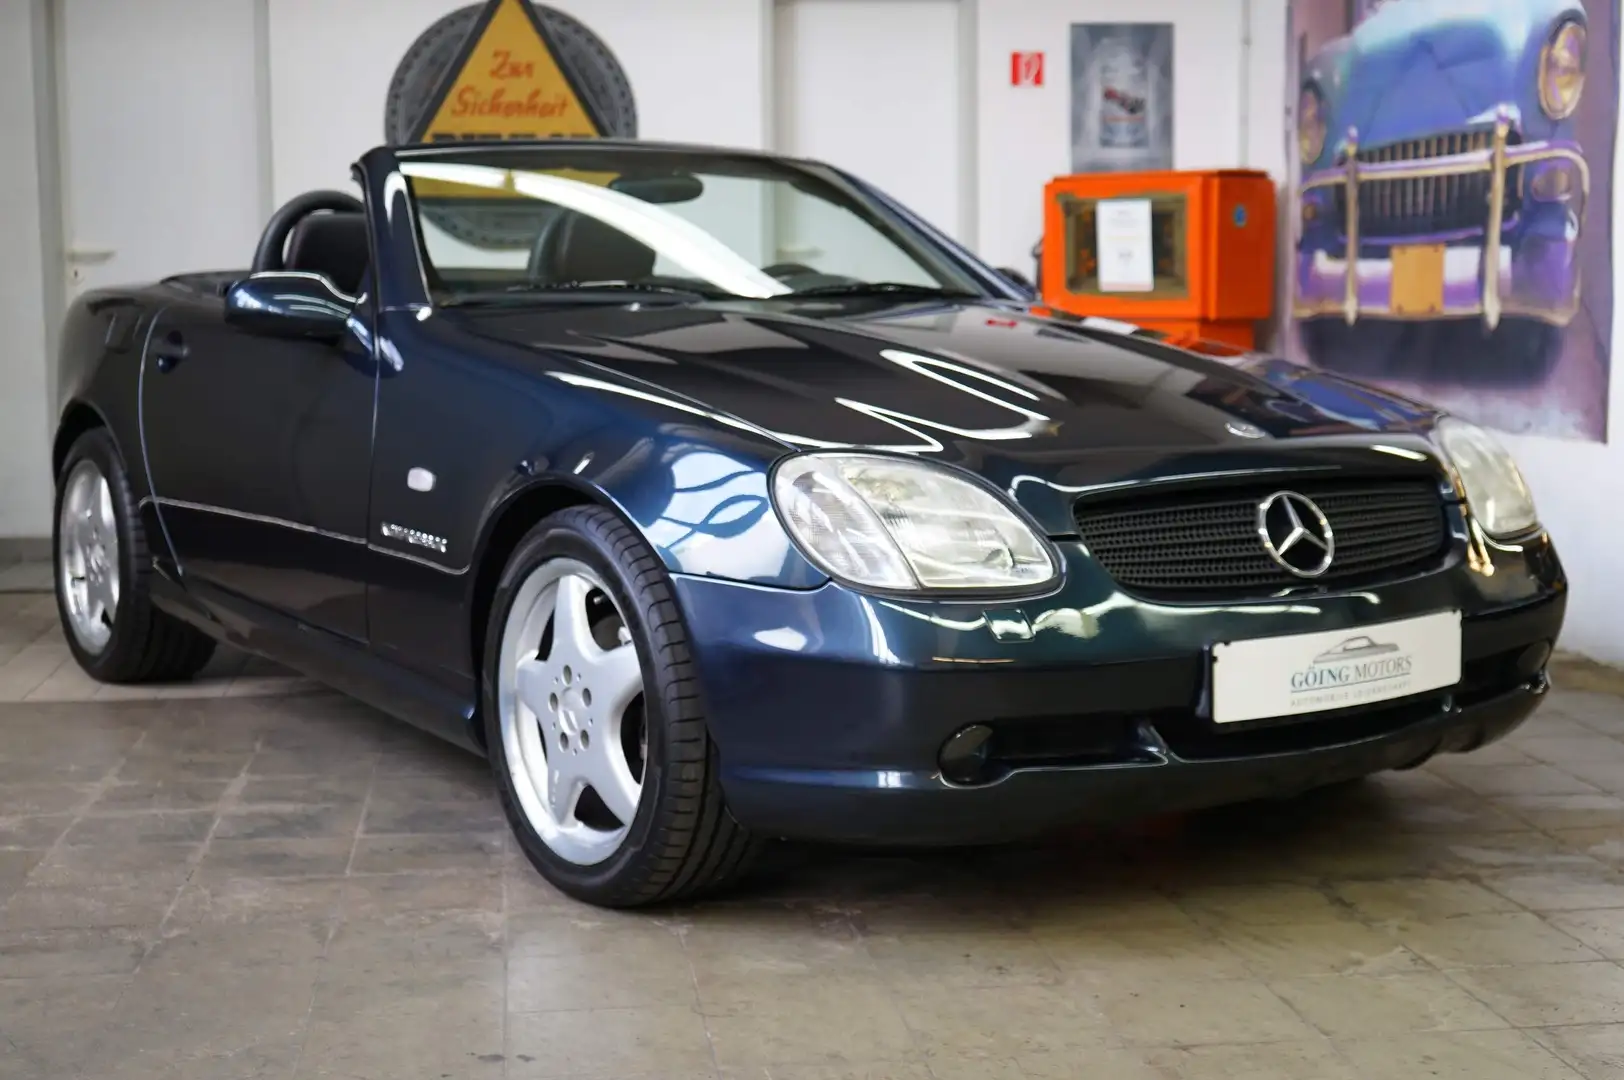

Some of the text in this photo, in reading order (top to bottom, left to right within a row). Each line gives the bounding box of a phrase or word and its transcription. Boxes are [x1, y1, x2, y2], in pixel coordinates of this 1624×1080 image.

[489, 50, 535, 79] Zur
[452, 85, 569, 118] Sicherheit
[1291, 655, 1412, 689] GÖING MOTORS
